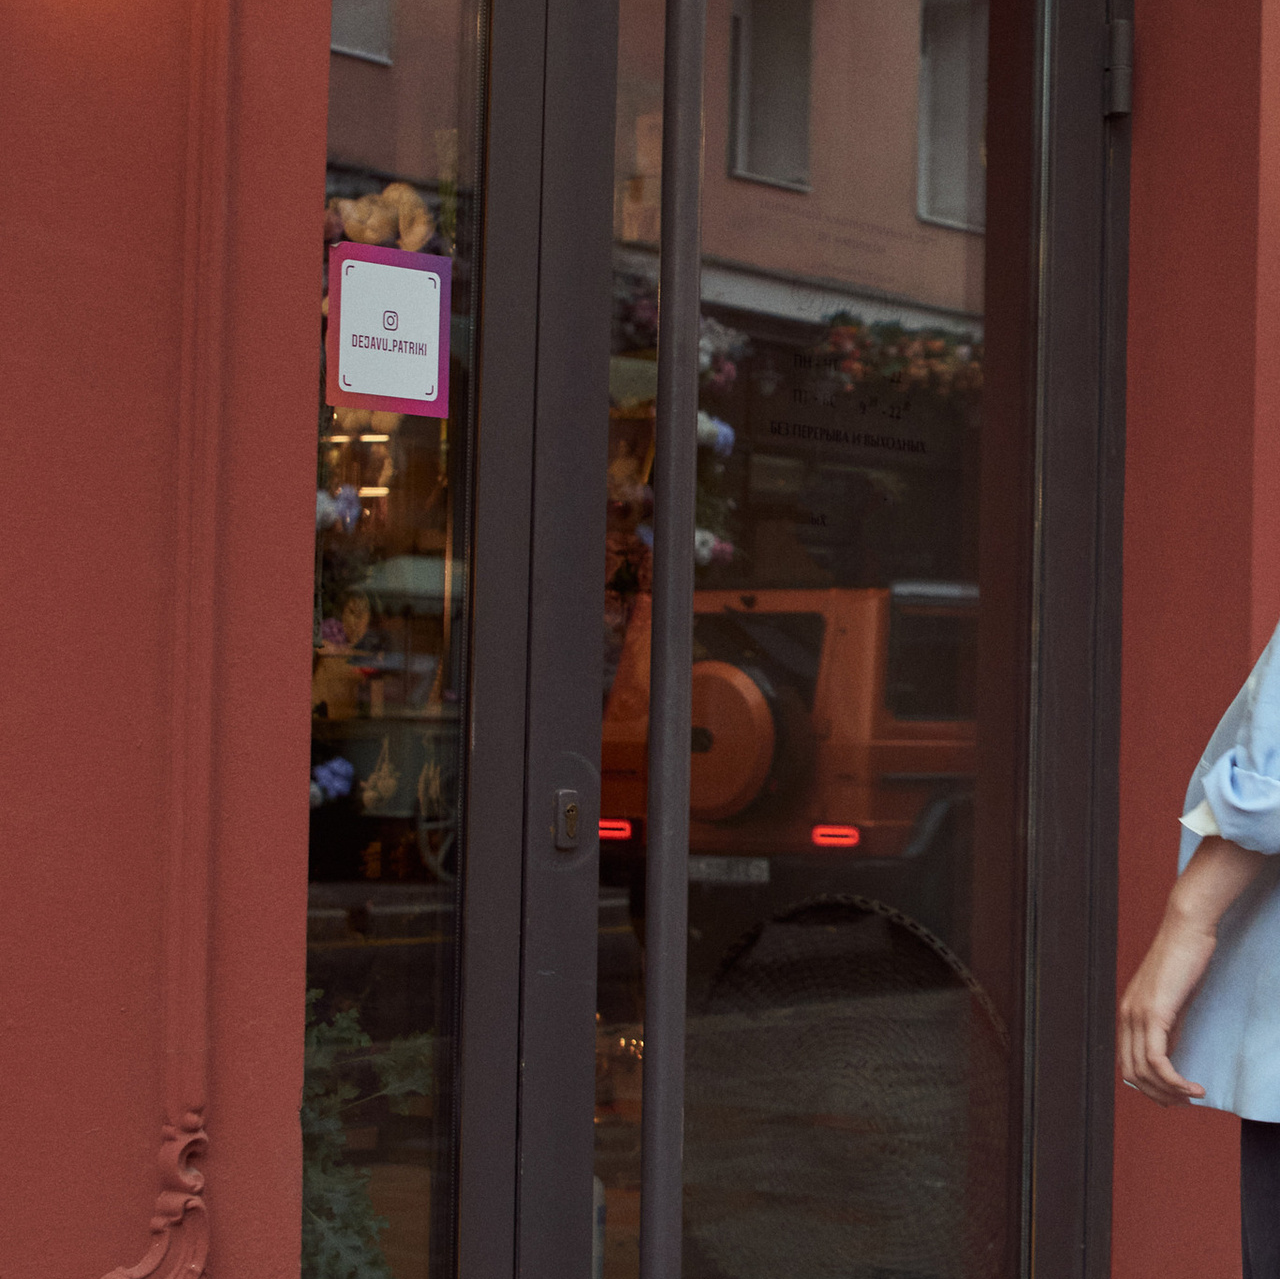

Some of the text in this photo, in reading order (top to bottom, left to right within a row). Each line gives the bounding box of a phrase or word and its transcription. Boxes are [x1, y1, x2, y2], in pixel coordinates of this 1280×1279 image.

[351, 333, 428, 357] DEJAVU_PATRIKI
[770, 420, 790, 437] БЕЗ
[792, 423, 850, 445] ПЕРЕРЫВА
[852, 432, 864, 446] И
